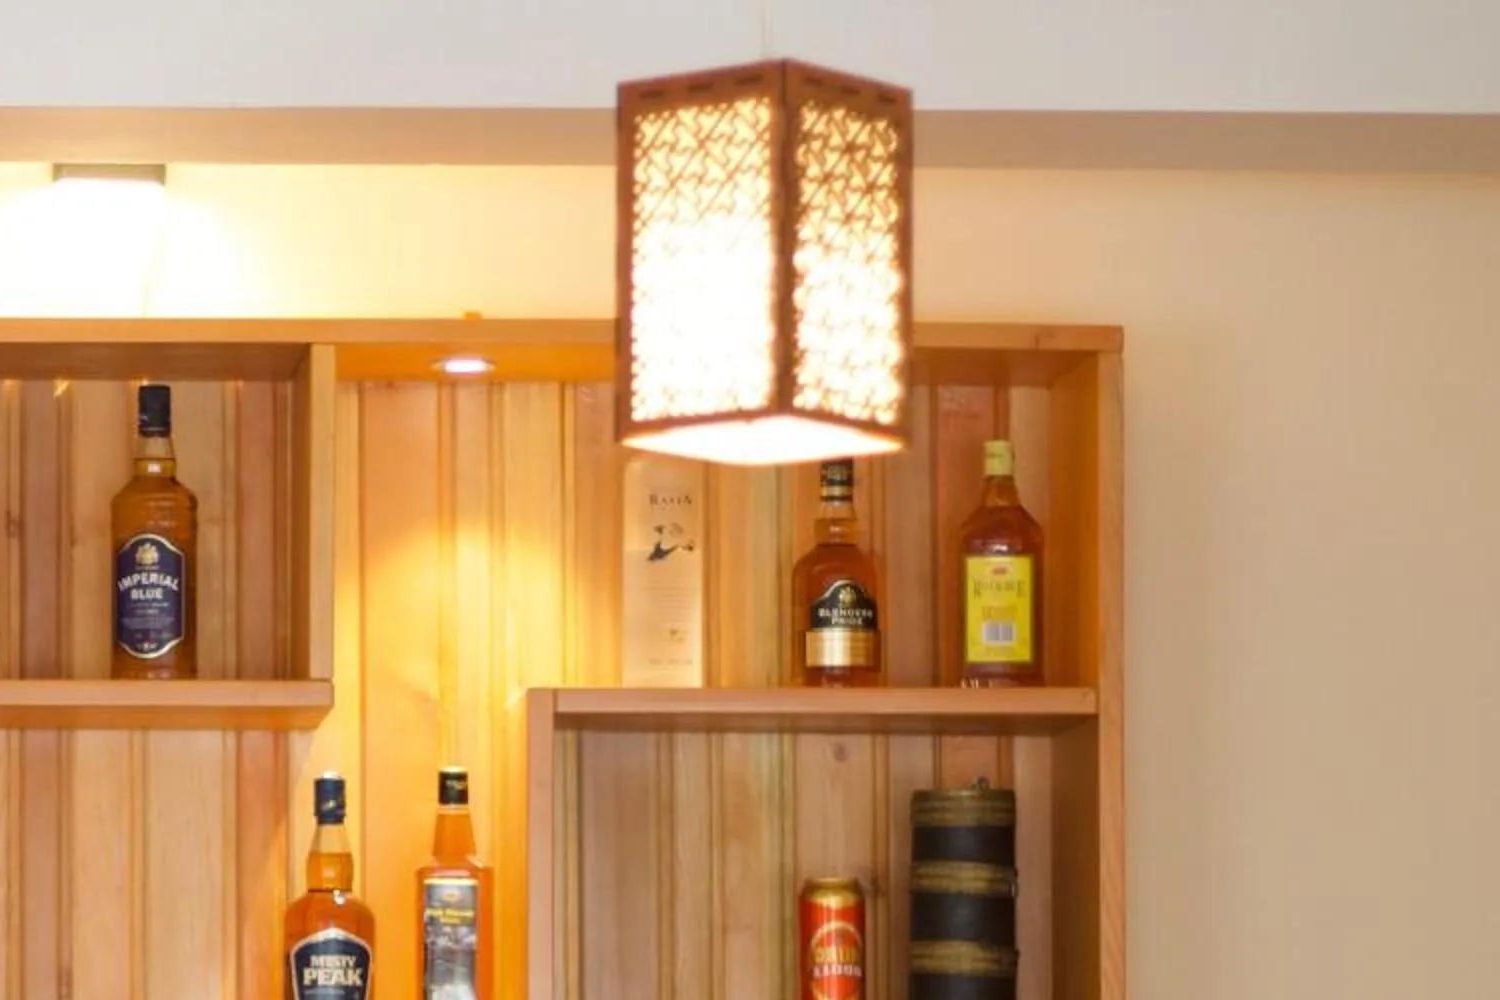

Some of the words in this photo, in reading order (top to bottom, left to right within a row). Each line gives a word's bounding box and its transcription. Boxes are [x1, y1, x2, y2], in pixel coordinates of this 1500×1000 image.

[117, 573, 180, 592] IMPERIAL
[131, 588, 164, 600] BLUE
[303, 968, 363, 986] PEAK
